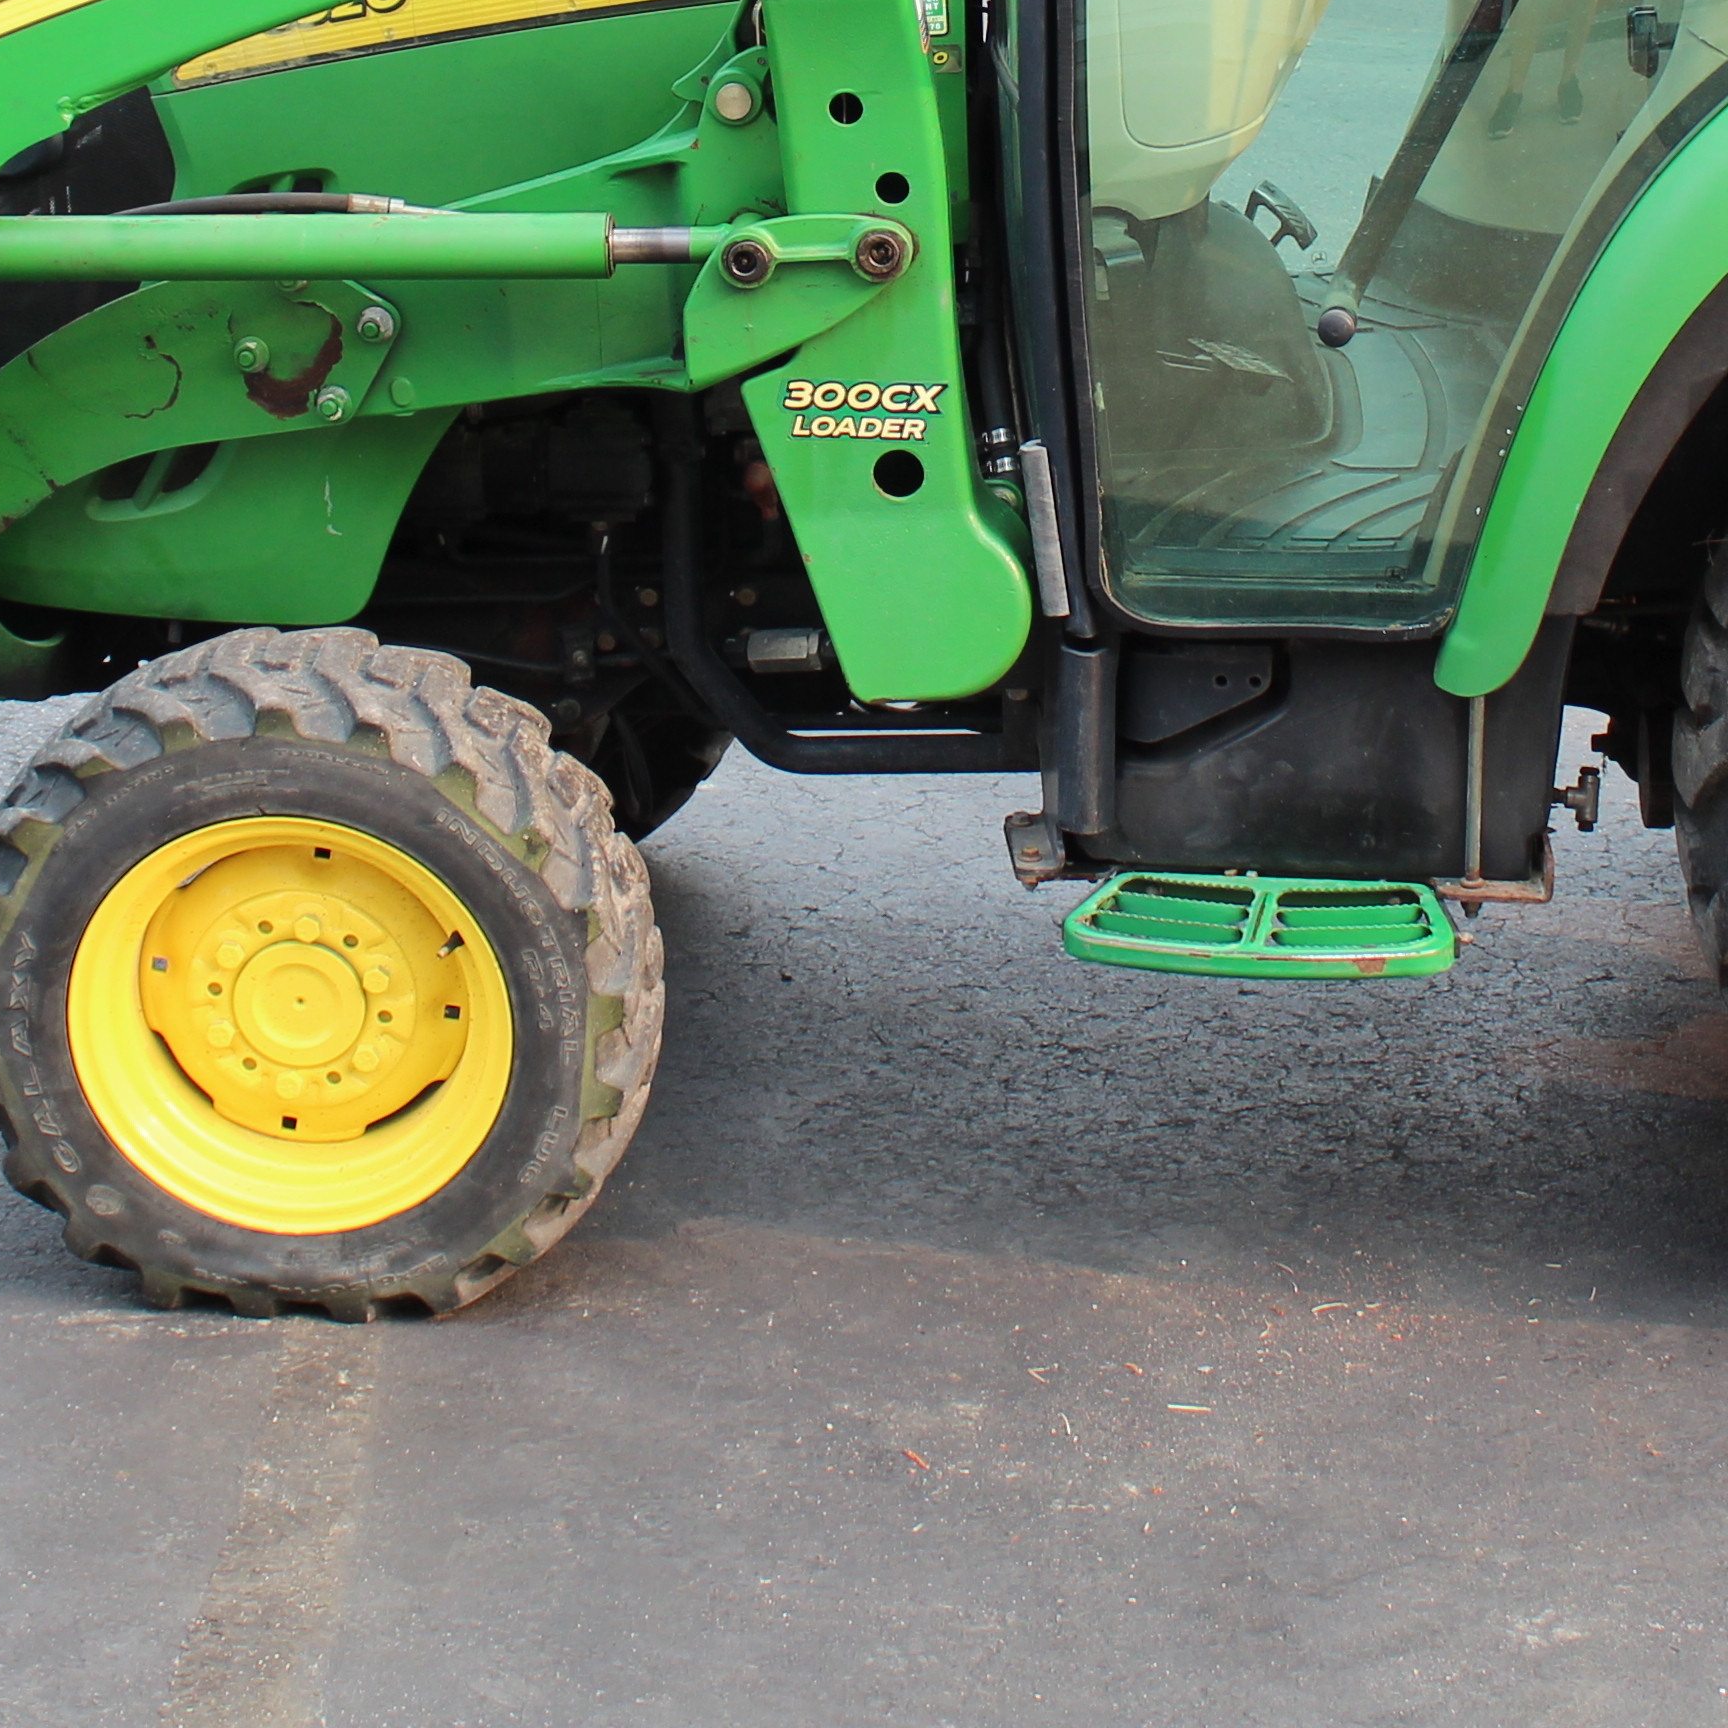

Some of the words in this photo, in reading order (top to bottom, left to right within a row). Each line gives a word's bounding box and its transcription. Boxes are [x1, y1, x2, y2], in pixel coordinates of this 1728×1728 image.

[783, 379, 948, 414] 300CX
[792, 414, 927, 441] LOADER
[7, 930, 83, 1174] GALAXY
[434, 806, 582, 1069] INDUSTRIAL
[517, 1104, 569, 1186] LUG
